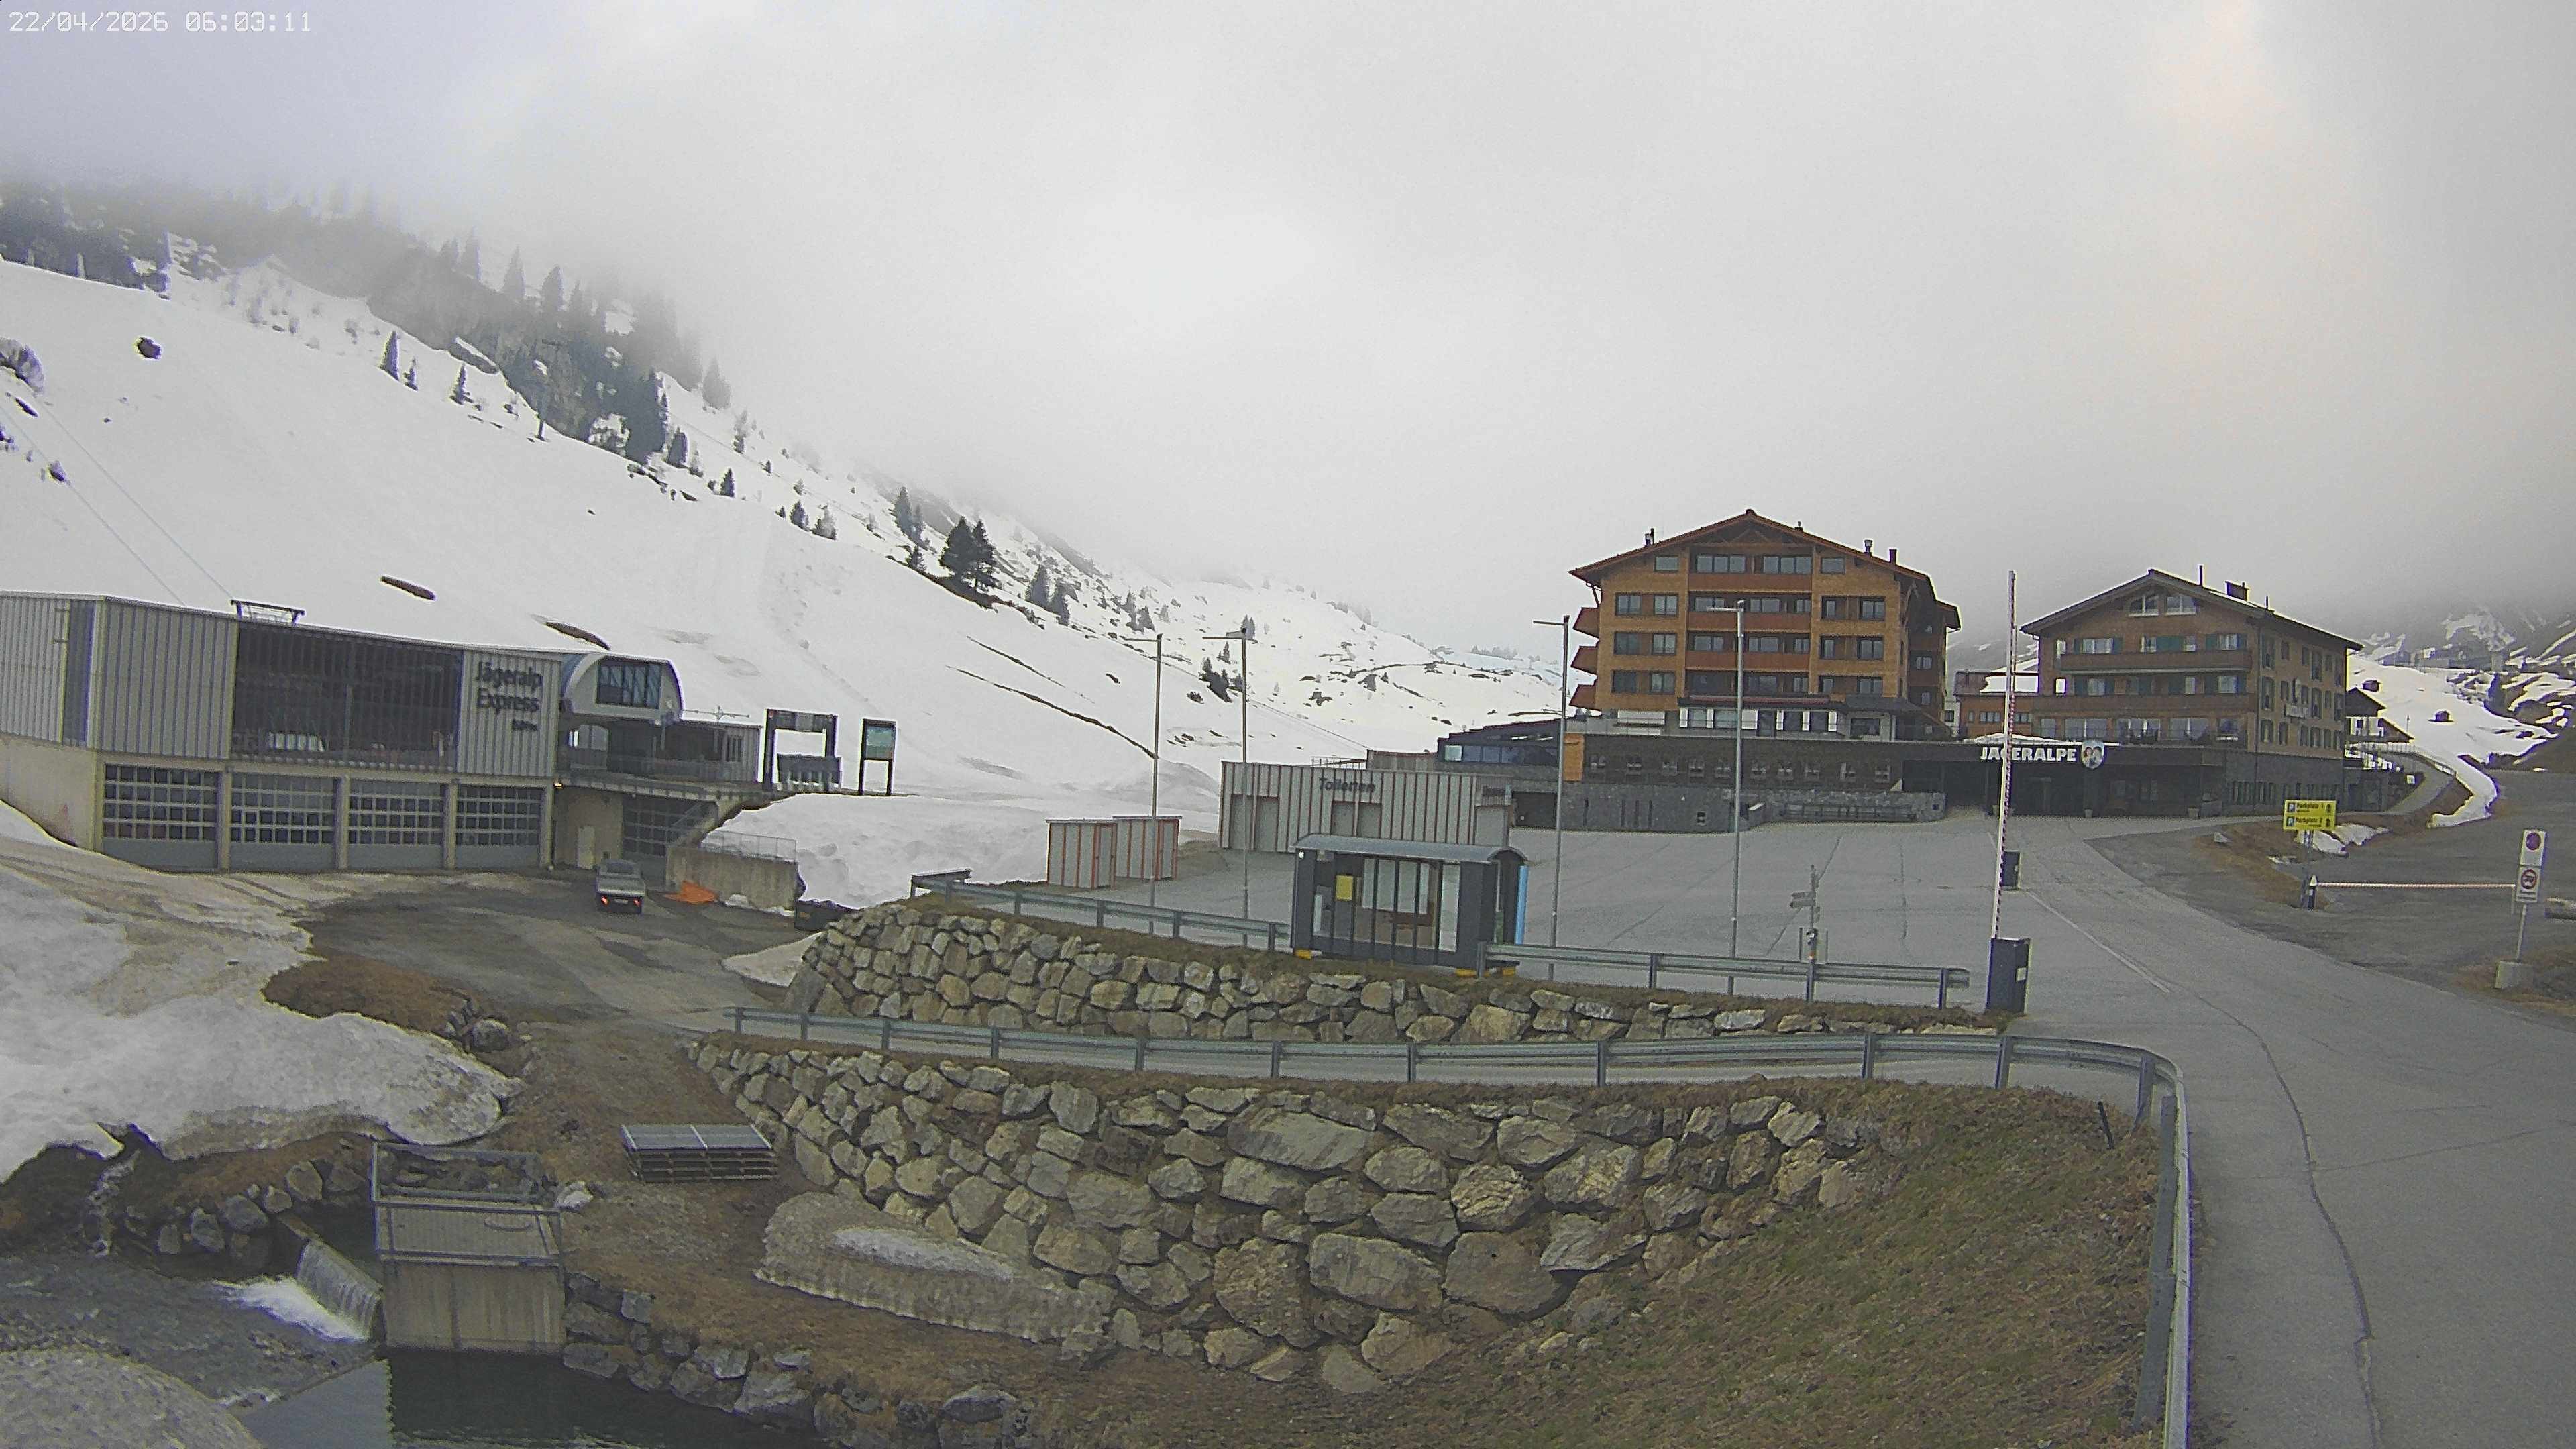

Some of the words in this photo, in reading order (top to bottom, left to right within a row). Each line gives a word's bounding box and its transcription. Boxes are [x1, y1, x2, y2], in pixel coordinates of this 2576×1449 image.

[476, 661, 543, 690] Jägeralp
[477, 687, 539, 714] Express
[1319, 777, 1375, 792] Toiletten
